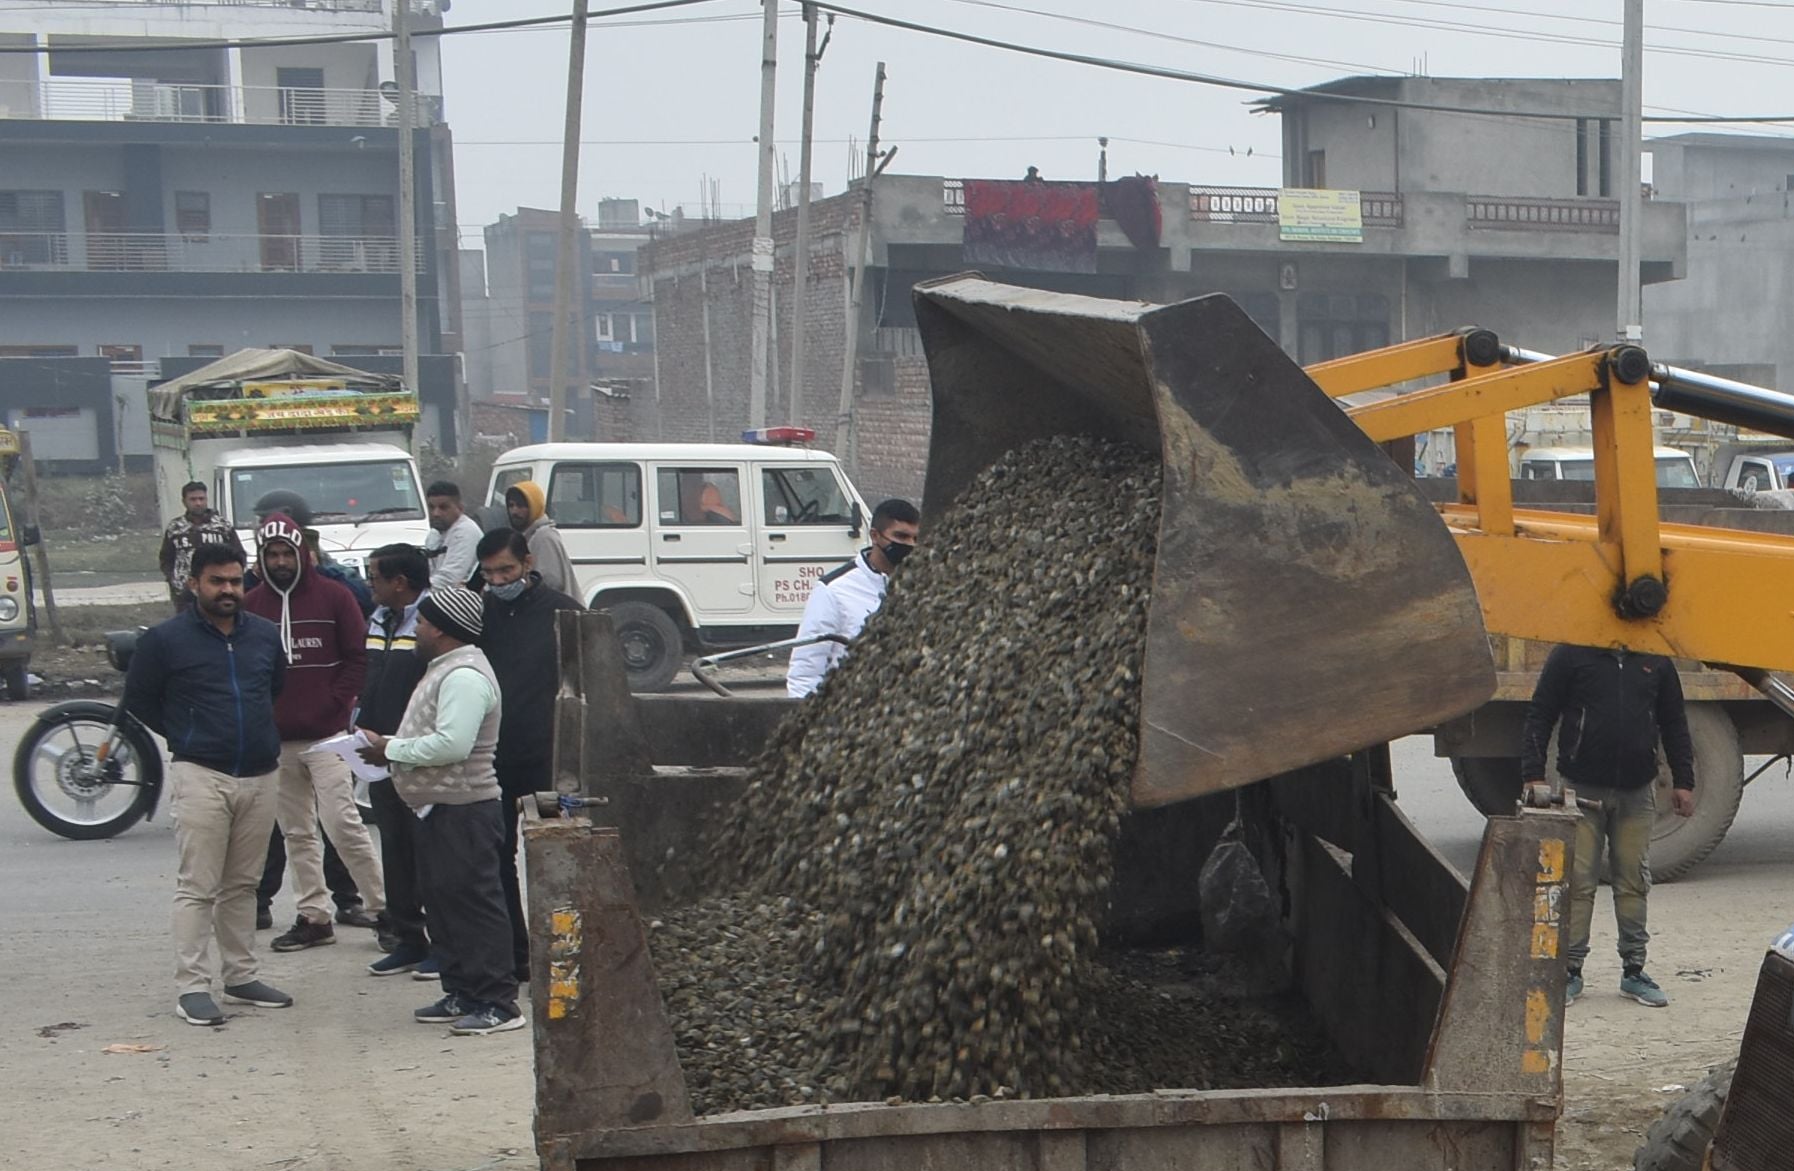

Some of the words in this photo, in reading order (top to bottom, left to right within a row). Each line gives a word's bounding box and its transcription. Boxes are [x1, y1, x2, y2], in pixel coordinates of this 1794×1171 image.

[799, 567, 824, 578] SHO
[775, 580, 790, 591] PS
[291, 637, 323, 649] LAUREN
